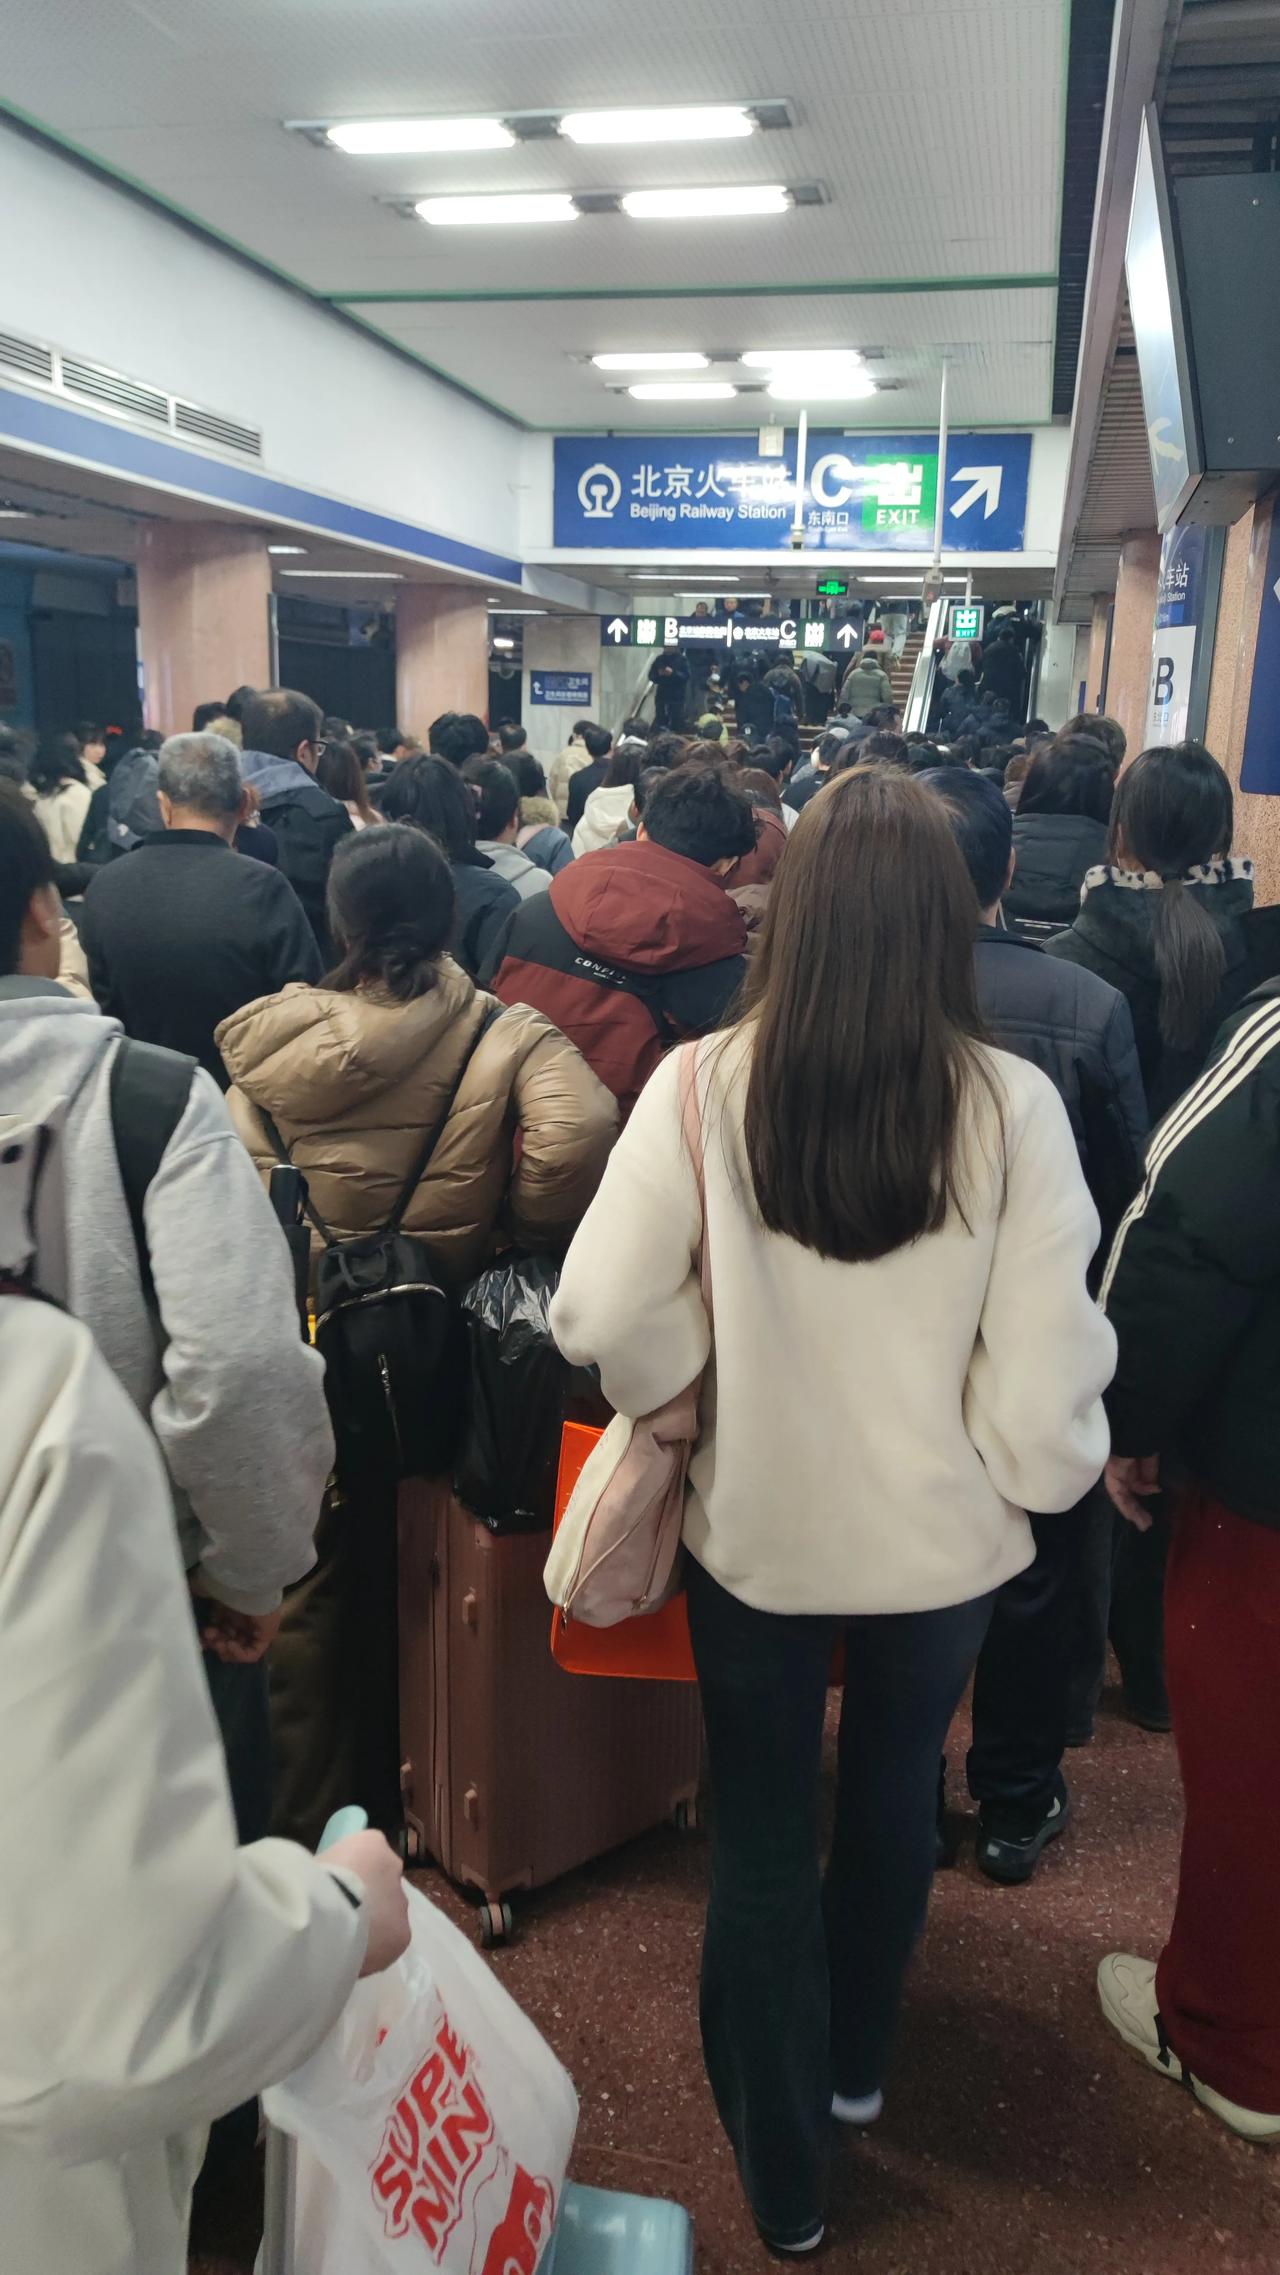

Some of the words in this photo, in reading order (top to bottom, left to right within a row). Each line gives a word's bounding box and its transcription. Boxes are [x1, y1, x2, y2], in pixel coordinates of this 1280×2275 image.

[811, 453, 854, 508] C
[630, 503, 676, 521] Beijing
[679, 503, 734, 522] Railway
[738, 504, 786, 519] Station
[808, 511, 849, 525] 东南口
[876, 509, 920, 525] EXIT
[1167, 592, 1186, 602] Station
[664, 617, 678, 638] B
[956, 610, 977, 628] 出
[780, 620, 796, 640] C
[955, 630, 976, 638] EXIT
[1154, 657, 1174, 705] B
